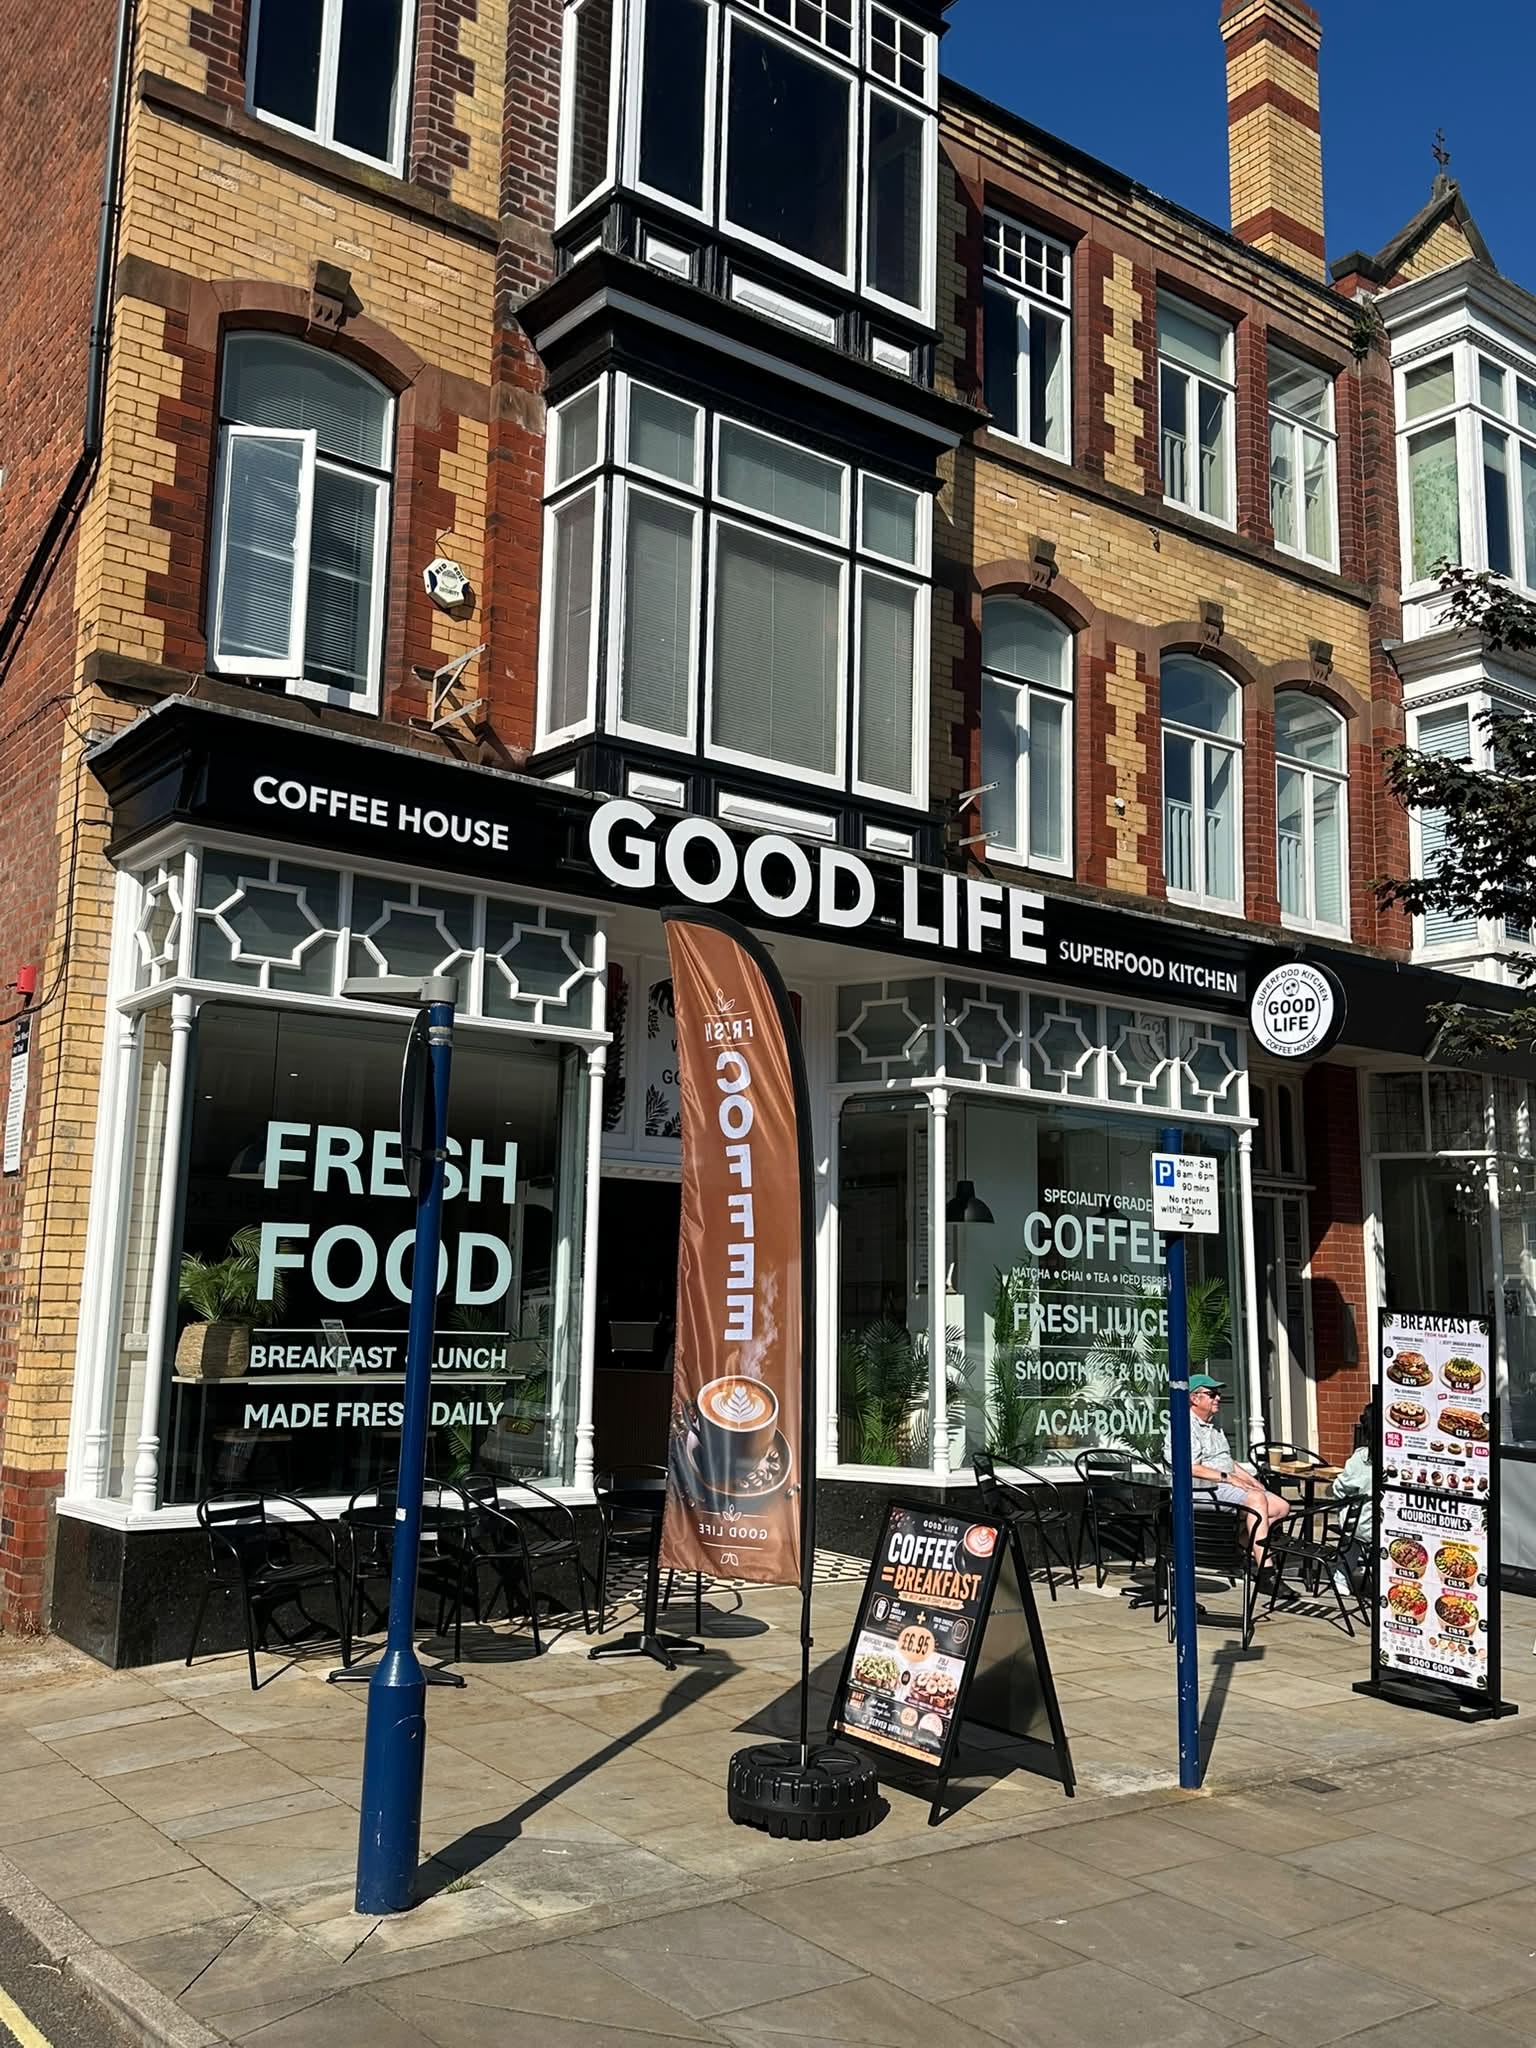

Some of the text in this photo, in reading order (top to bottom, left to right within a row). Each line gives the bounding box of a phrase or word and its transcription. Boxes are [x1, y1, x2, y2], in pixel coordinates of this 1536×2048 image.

[252, 775, 510, 851] COFFEE HOUSE
[588, 800, 1048, 965] GOOD LIFE
[1059, 940, 1238, 993] SUPERFOOD KITCHEN
[1257, 968, 1328, 1006] SUPERFOOD KITCHEN
[1268, 998, 1315, 1015] GOOD
[1273, 1016, 1308, 1032] LIFE
[1265, 1034, 1319, 1054] COFFEE HOUSE
[1159, 1162, 1172, 1184] P
[1179, 1158, 1212, 1169] Mon Sat
[1182, 1183, 1192, 1191] 90
[1044, 1188, 1153, 1212] SPECIALITY GRADE
[1168, 1194, 1204, 1204] No return
[1161, 1205, 1212, 1216] within 2 hours
[256, 1221, 513, 1306] FOOD
[1012, 1267, 1168, 1287] MATCHA CHAI TEA ICED ESPRE
[1013, 1303, 1097, 1333] FRESH
[1400, 1314, 1472, 1335] BREAKFAST
[249, 1345, 397, 1370] BREAKFAST
[431, 1347, 507, 1369] UNCH
[1134, 1362, 1170, 1381] BOW
[243, 1402, 505, 1429] MADE FRES DAILY
[1034, 1408, 1171, 1436] ACAI BOWLS
[1405, 1493, 1458, 1515] LUNCH
[923, 1519, 942, 1531] GOOD
[944, 1524, 960, 1535] LIFE
[1401, 1508, 1438, 1525] NOURISH
[1438, 1514, 1469, 1531] BOWLS
[887, 1532, 957, 1571] COFFEE
[894, 1565, 982, 1601] BREAKFAST
[900, 1632, 931, 1656] £6.95
[1409, 1657, 1454, 1675] SOOO GOOD
